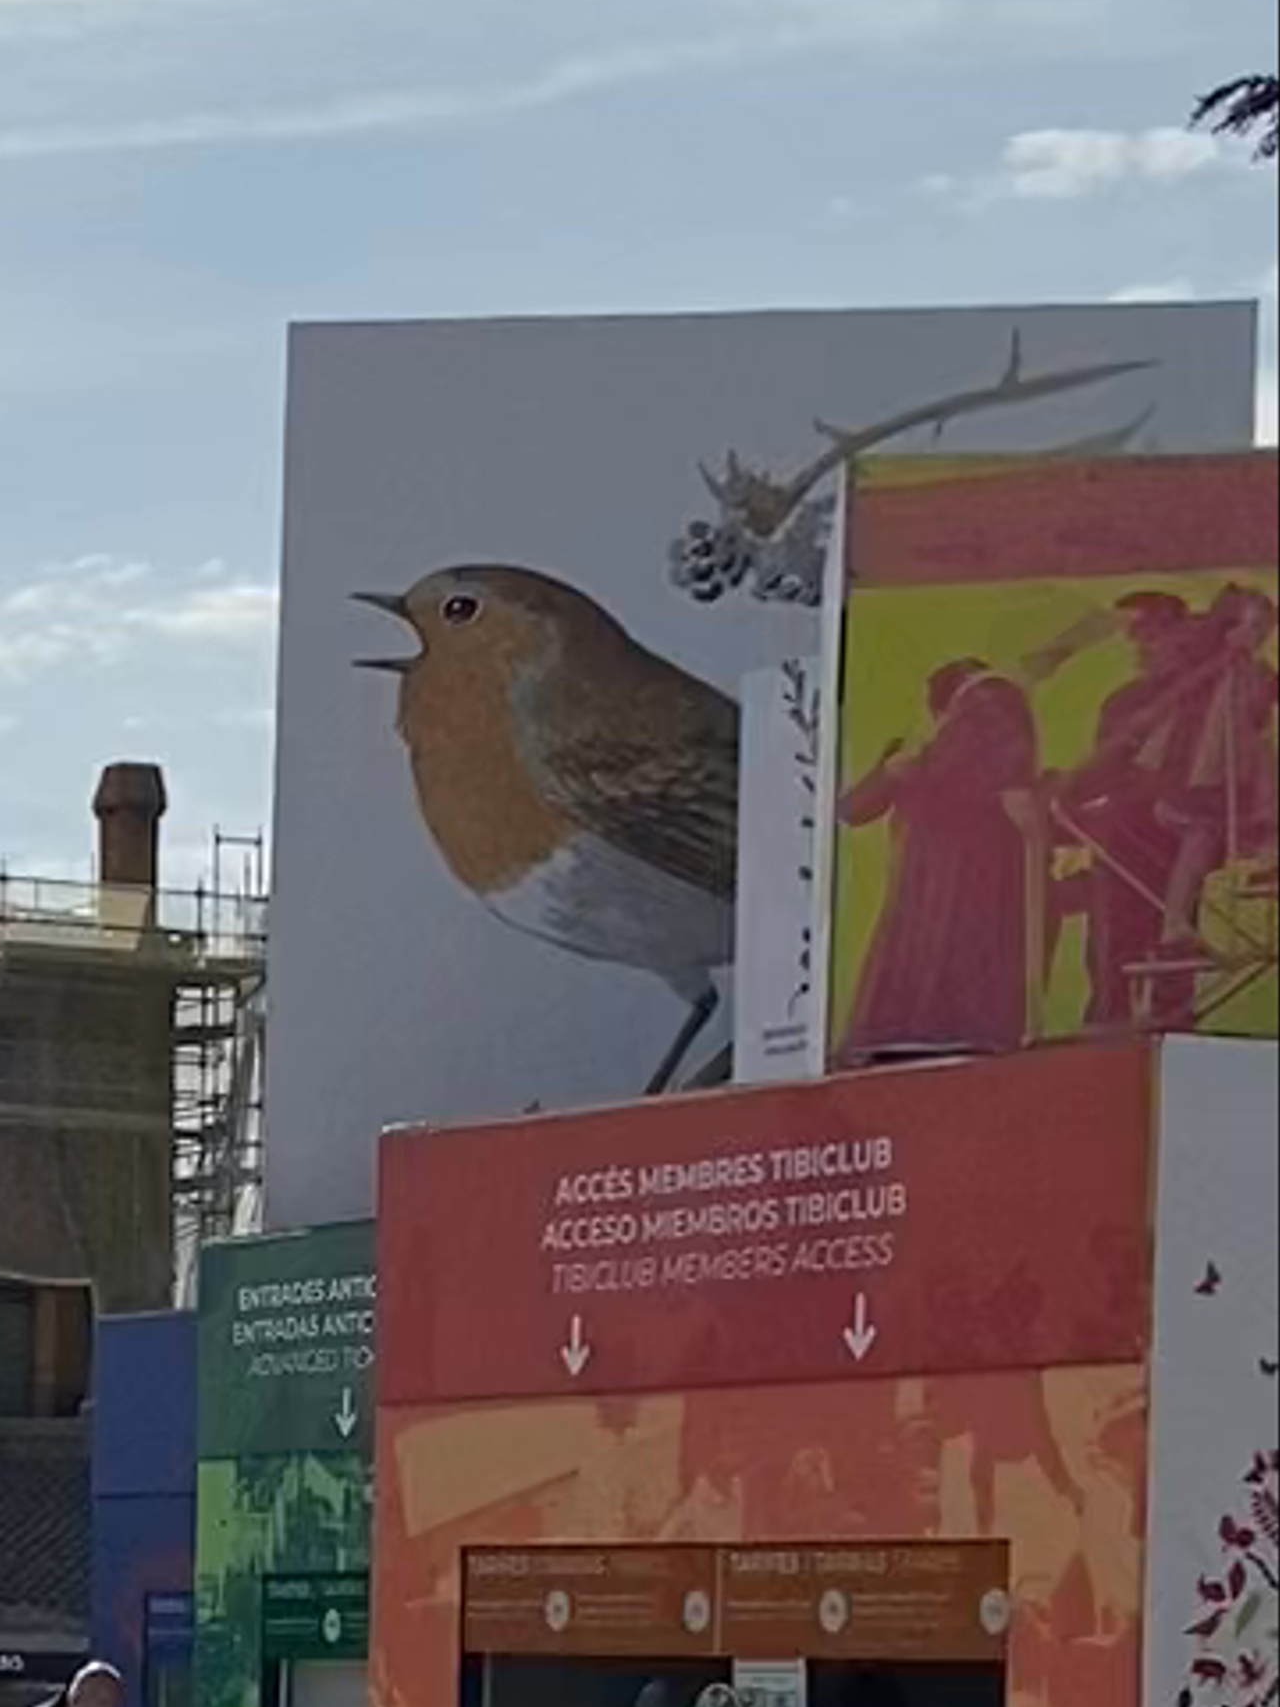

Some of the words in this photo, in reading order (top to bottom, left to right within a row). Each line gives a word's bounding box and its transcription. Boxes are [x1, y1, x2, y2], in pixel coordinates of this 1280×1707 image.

[638, 1152, 765, 1195] MEMBRES
[769, 1137, 893, 1180] TIBICLUB
[541, 1215, 636, 1251] ACCESO
[642, 1200, 779, 1241] MIEMBROS
[785, 1184, 907, 1226] TIBICLUB
[552, 1257, 654, 1293] TIBICLUB
[661, 1244, 787, 1286] MEMBERS
[792, 1233, 894, 1271] ACCESS
[239, 1278, 325, 1311] ENTRADES
[326, 1274, 376, 1301] ANTIC
[232, 1313, 319, 1345] ENTRADAS
